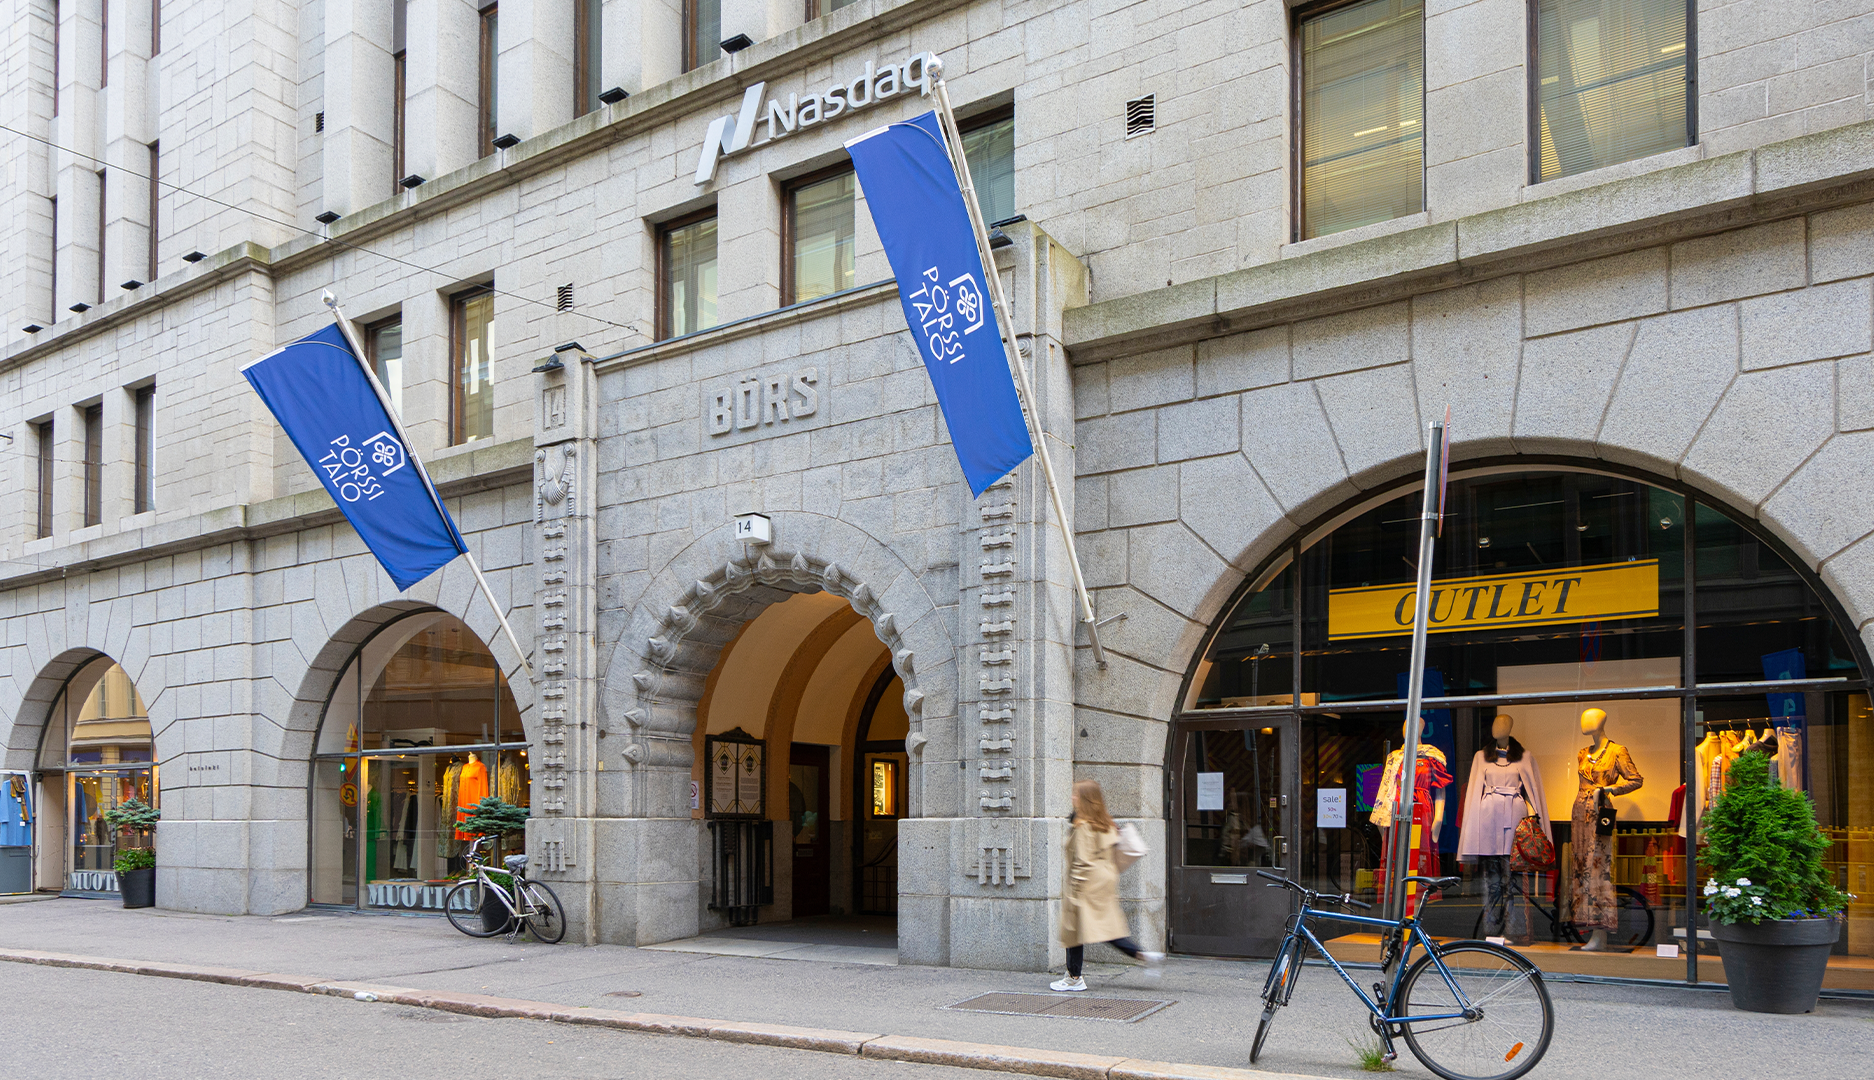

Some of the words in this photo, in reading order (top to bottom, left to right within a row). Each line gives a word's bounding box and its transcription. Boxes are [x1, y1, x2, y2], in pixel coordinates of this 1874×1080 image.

[768, 51, 931, 140] Nasdaq
[909, 282, 944, 361] TALO
[923, 266, 965, 364] PÖRSSI
[709, 367, 818, 436] BÖRS
[318, 449, 361, 502] TALO
[330, 434, 385, 501] PÖRSSI
[738, 520, 751, 534] 14
[1394, 577, 1582, 626] OUTLET
[1322, 795, 1342, 803] sale!
